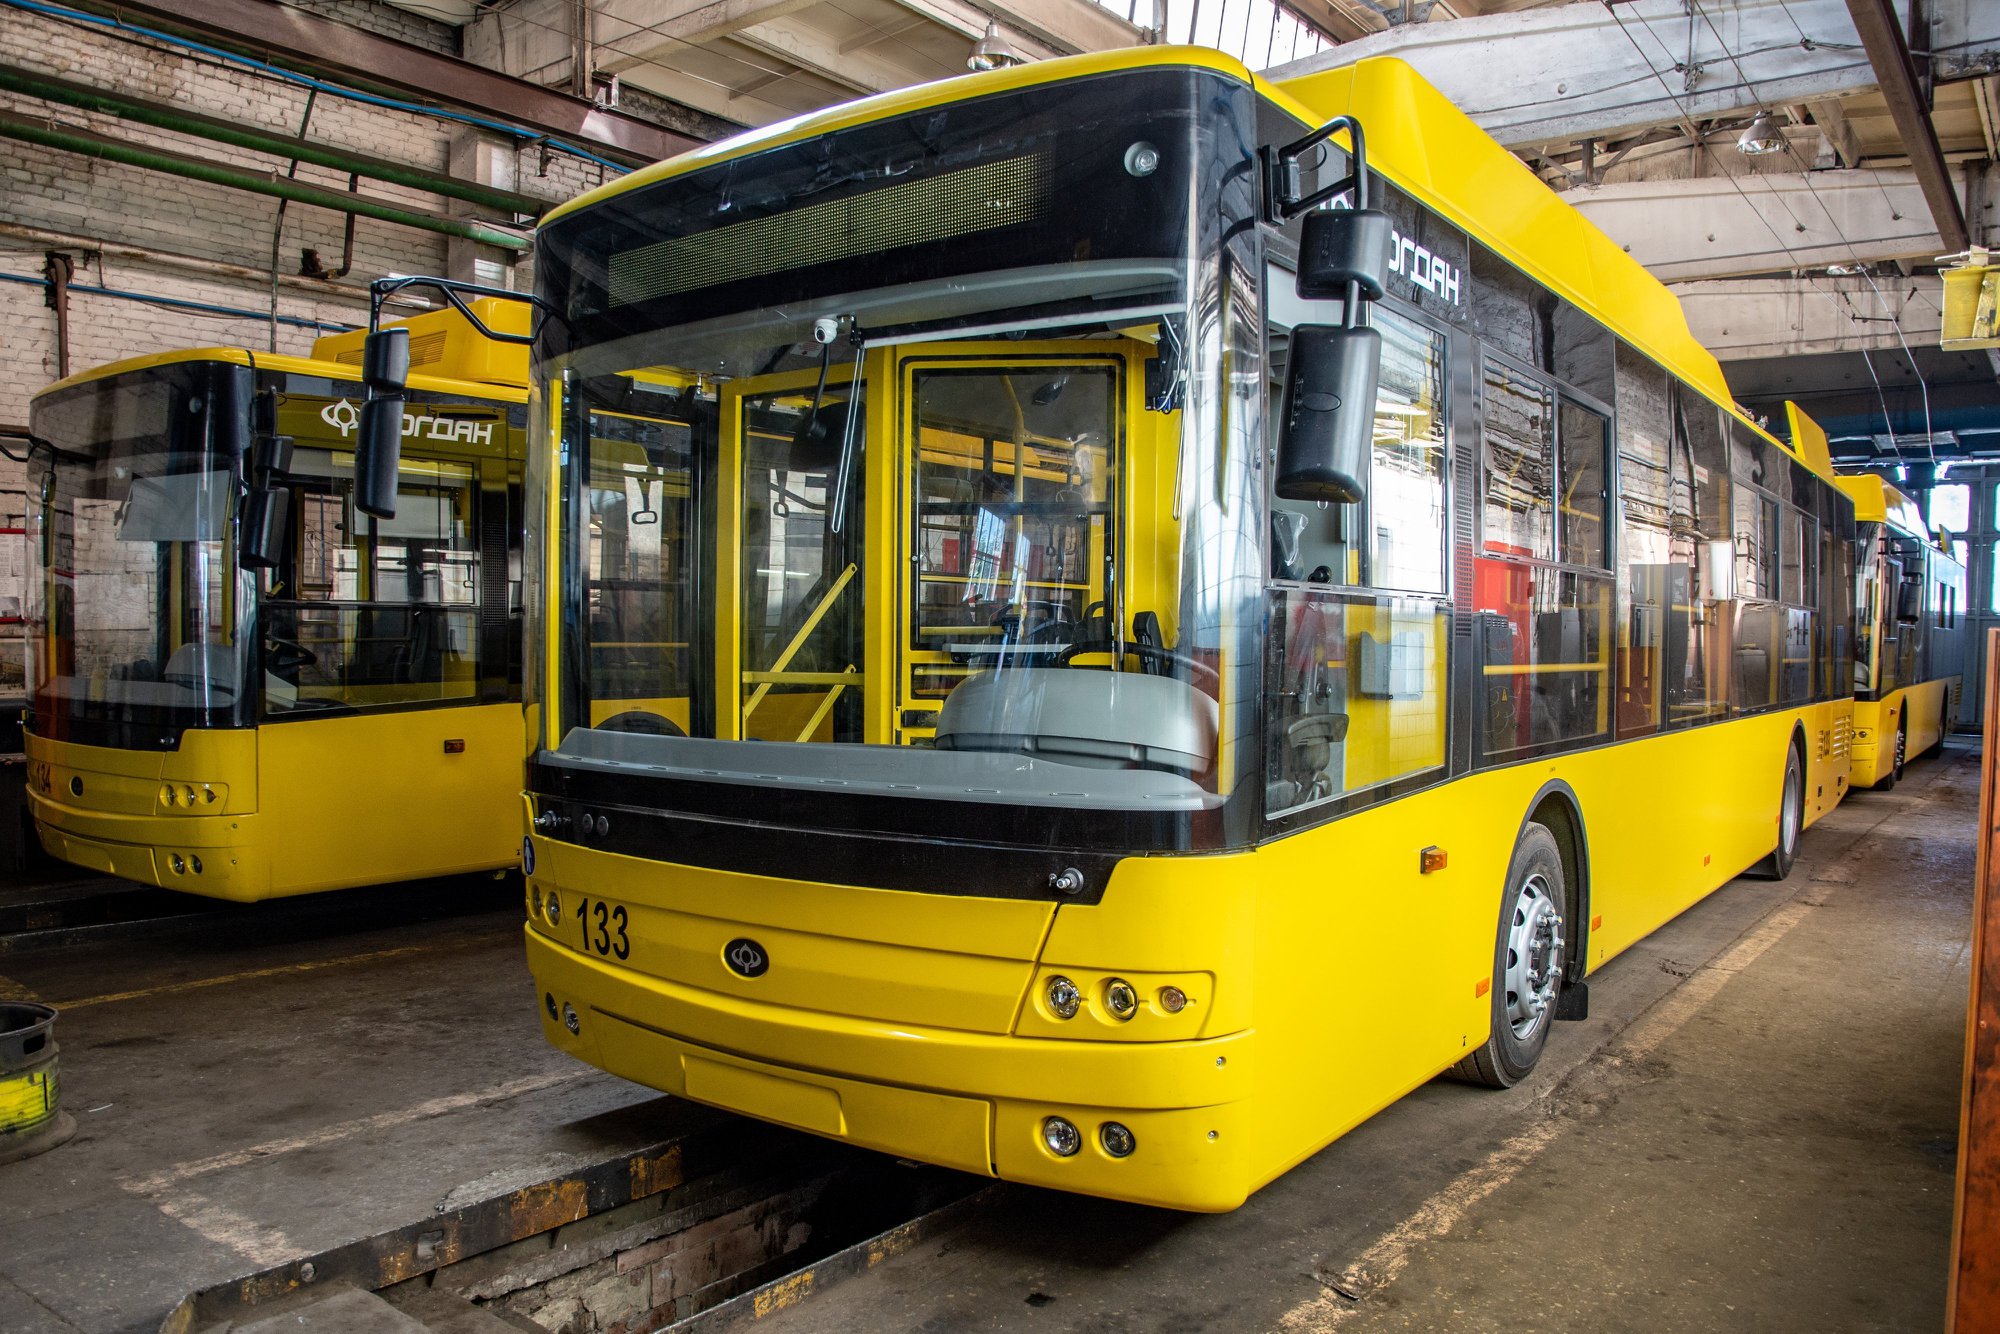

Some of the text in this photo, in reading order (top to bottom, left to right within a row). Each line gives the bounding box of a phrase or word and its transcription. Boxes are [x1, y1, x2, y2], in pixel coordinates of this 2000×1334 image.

[1388, 230, 1460, 306] ОГДАН
[401, 413, 493, 445] ОГДАН
[36, 763, 52, 794] 134
[577, 897, 630, 961] 133
